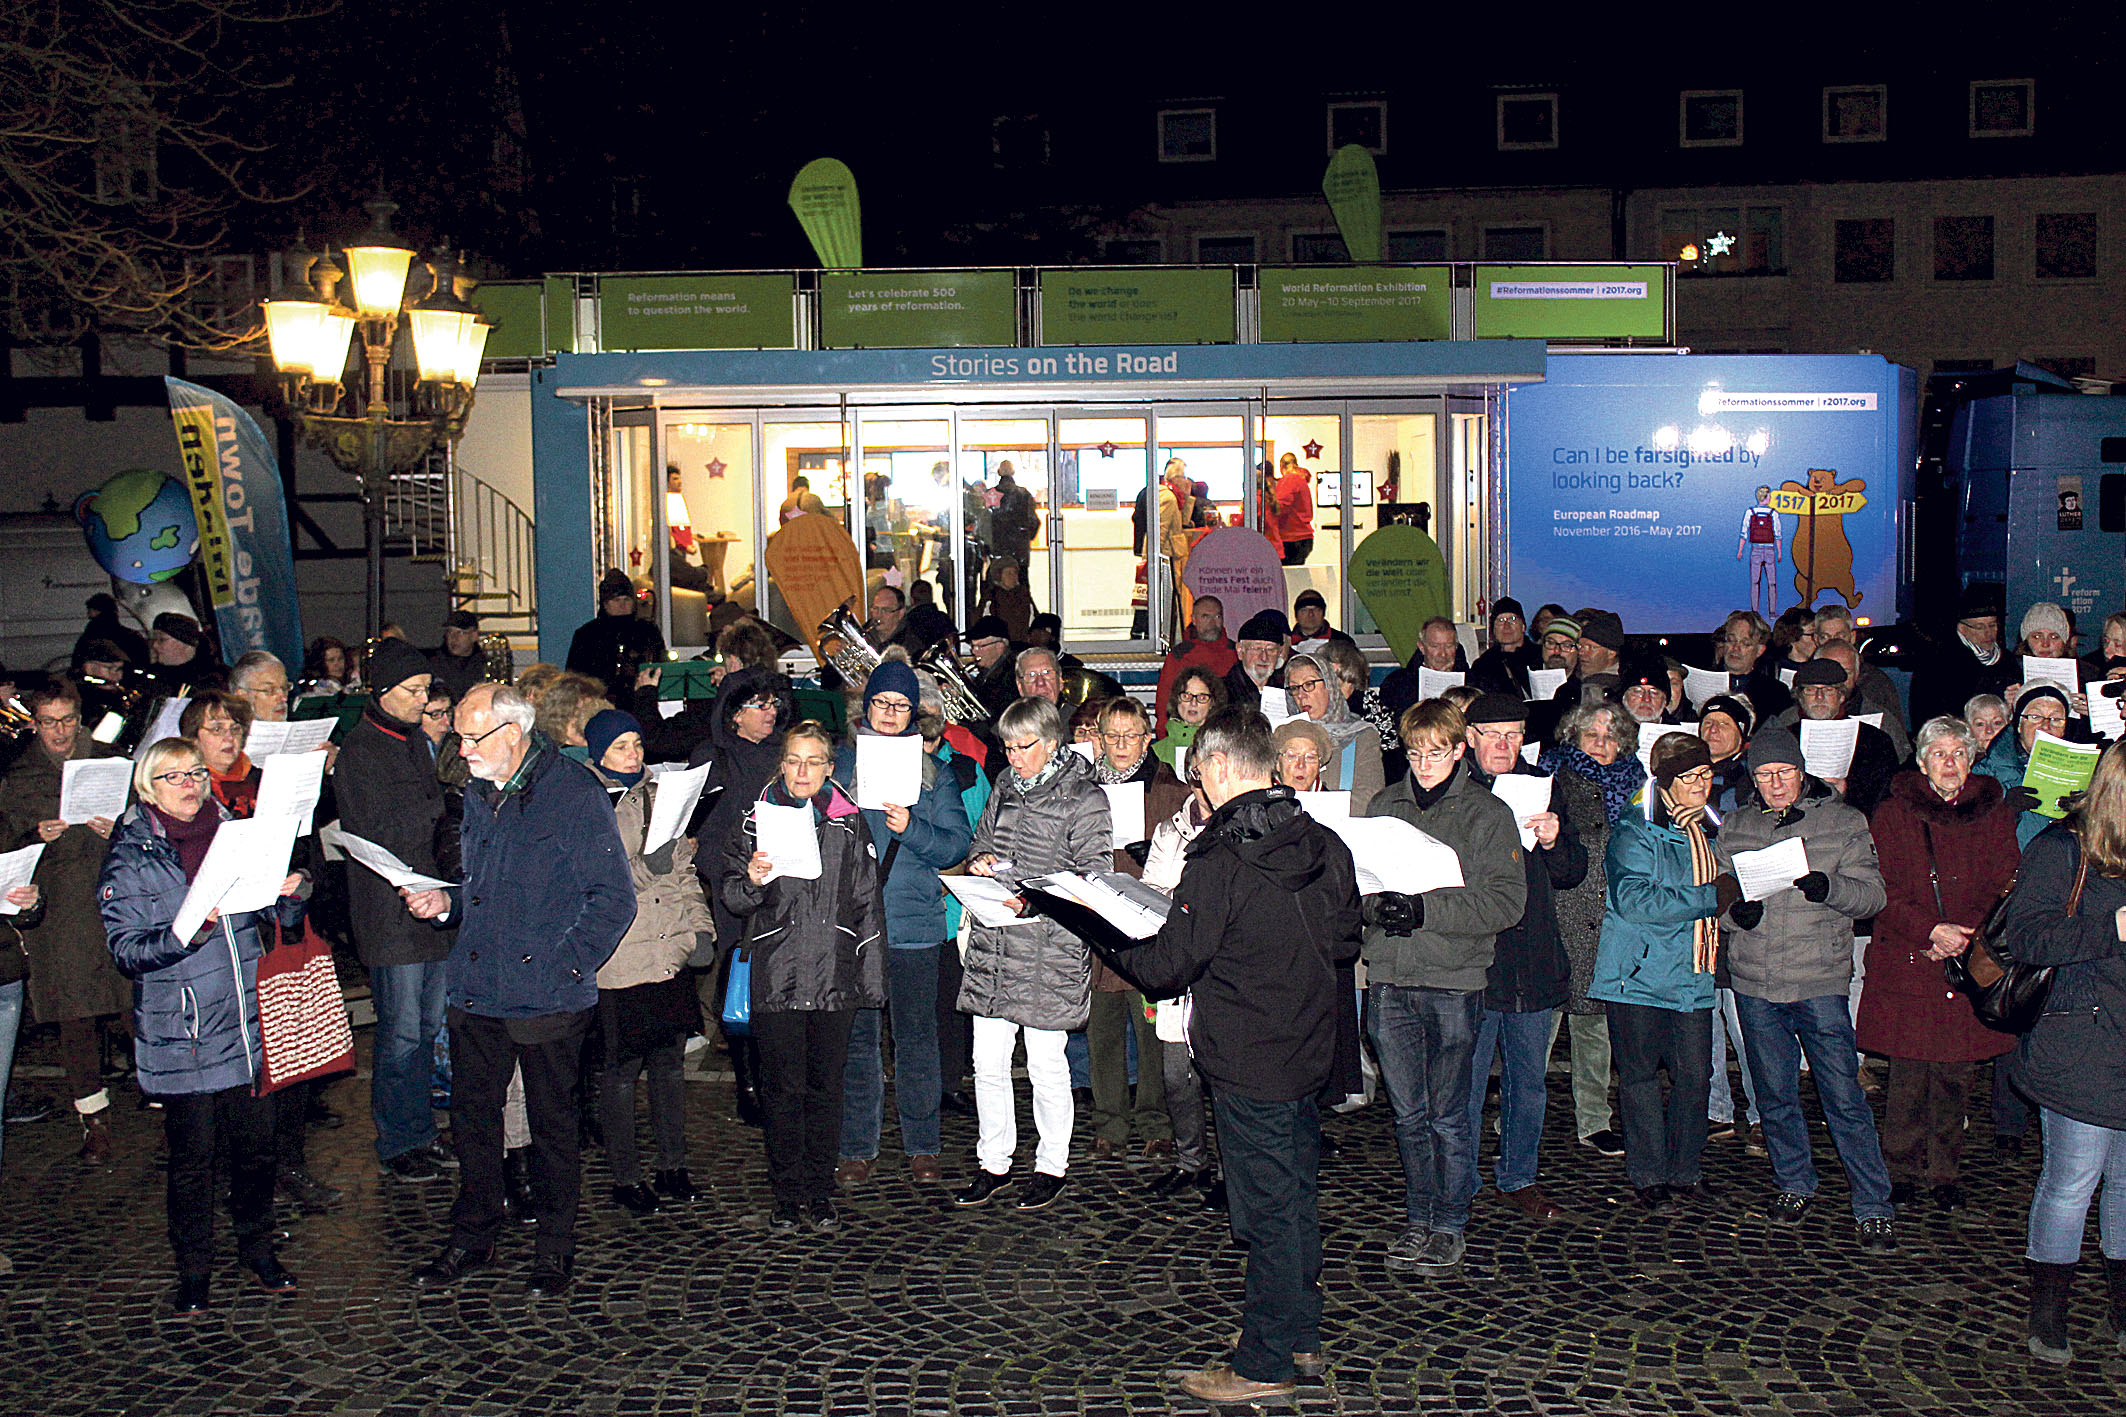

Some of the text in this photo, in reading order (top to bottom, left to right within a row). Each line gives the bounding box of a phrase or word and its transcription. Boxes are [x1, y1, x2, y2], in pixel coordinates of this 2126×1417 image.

[848, 287, 956, 298] Let's celebrate 500
[1282, 282, 1427, 293] World Reformation Exhibition
[1496, 285, 1642, 296] #Reformationssommer r2017.org
[628, 292, 736, 302] Reformation means
[1282, 297, 1295, 307] 20
[1341, 296, 1395, 308] September
[1398, 296, 1421, 306] 2017
[628, 304, 752, 316] to question the world.
[848, 301, 965, 312] years of reformation.
[931, 352, 1178, 376] Stories on the Road
[1822, 398, 1866, 408] r2017.org
[1553, 448, 1588, 464] Can
[1595, 447, 1599, 463] I
[1606, 446, 1629, 463] be
[1739, 446, 1760, 468] by
[1553, 471, 1684, 494] looking back?
[1775, 494, 1806, 509] 1517
[1818, 495, 1855, 509] 2017
[1553, 509, 1660, 522] European Roadmap
[1553, 526, 1610, 536] November
[1676, 525, 1702, 536] 2017
[1230, 575, 1250, 584] Fest
